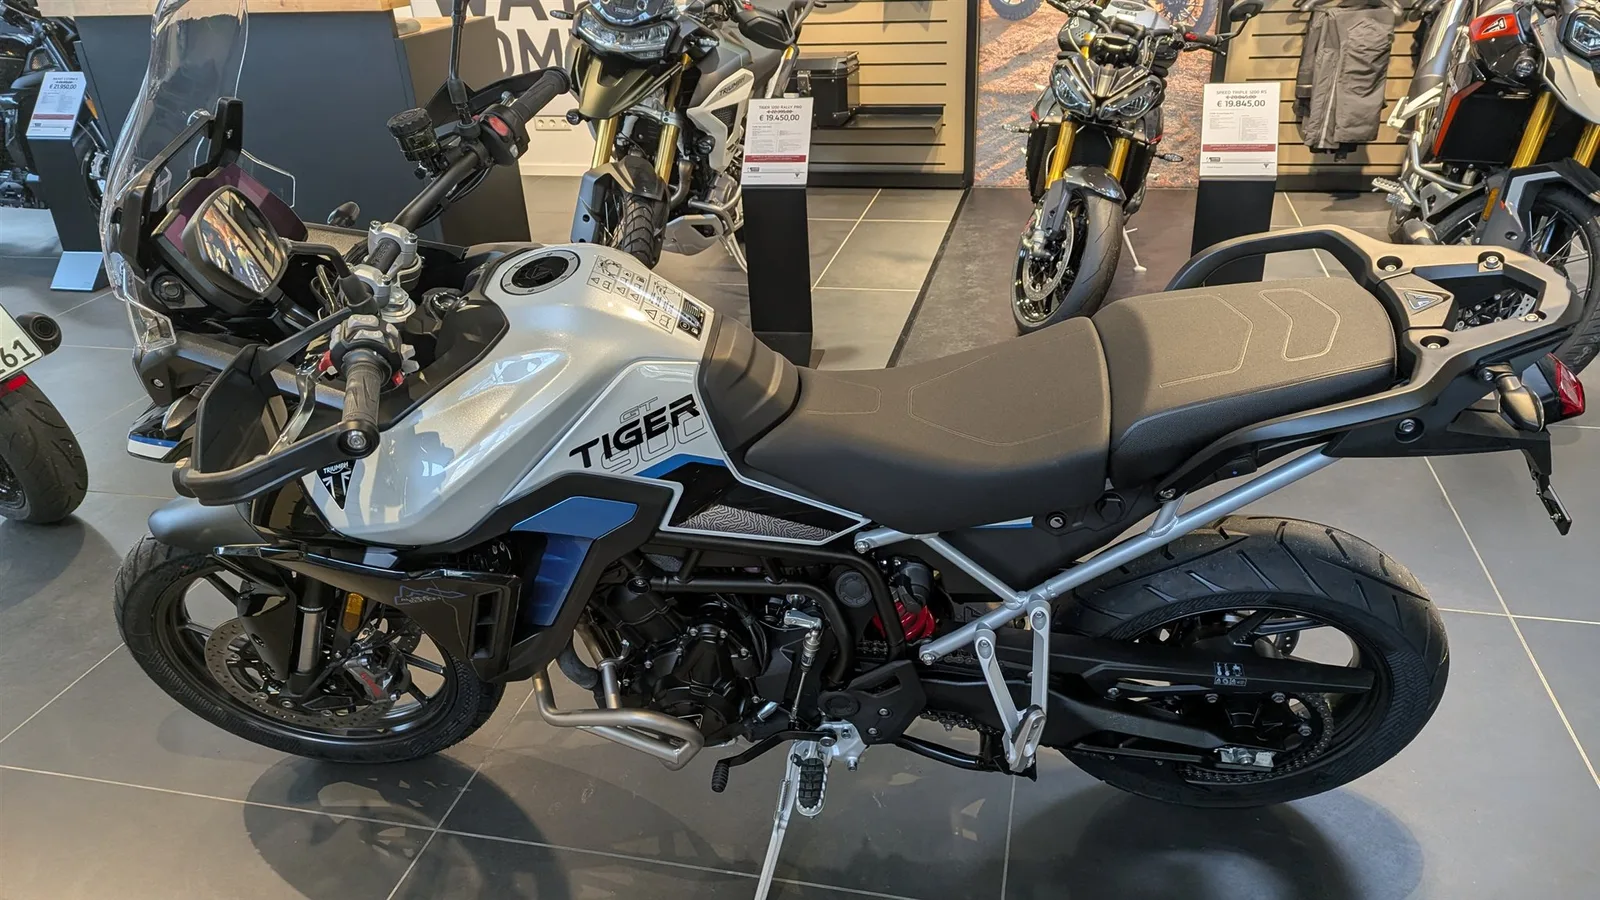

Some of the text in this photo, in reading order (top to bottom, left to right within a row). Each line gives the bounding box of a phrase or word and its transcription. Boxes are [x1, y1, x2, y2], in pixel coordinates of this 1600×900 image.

[1225, 99, 1266, 108] 19.845,00
[766, 114, 800, 122] 19.450,00
[0, 339, 36, 374] 61
[619, 396, 659, 424] GT
[569, 394, 700, 468] TIGER
[322, 461, 349, 474] TRIUMPH
